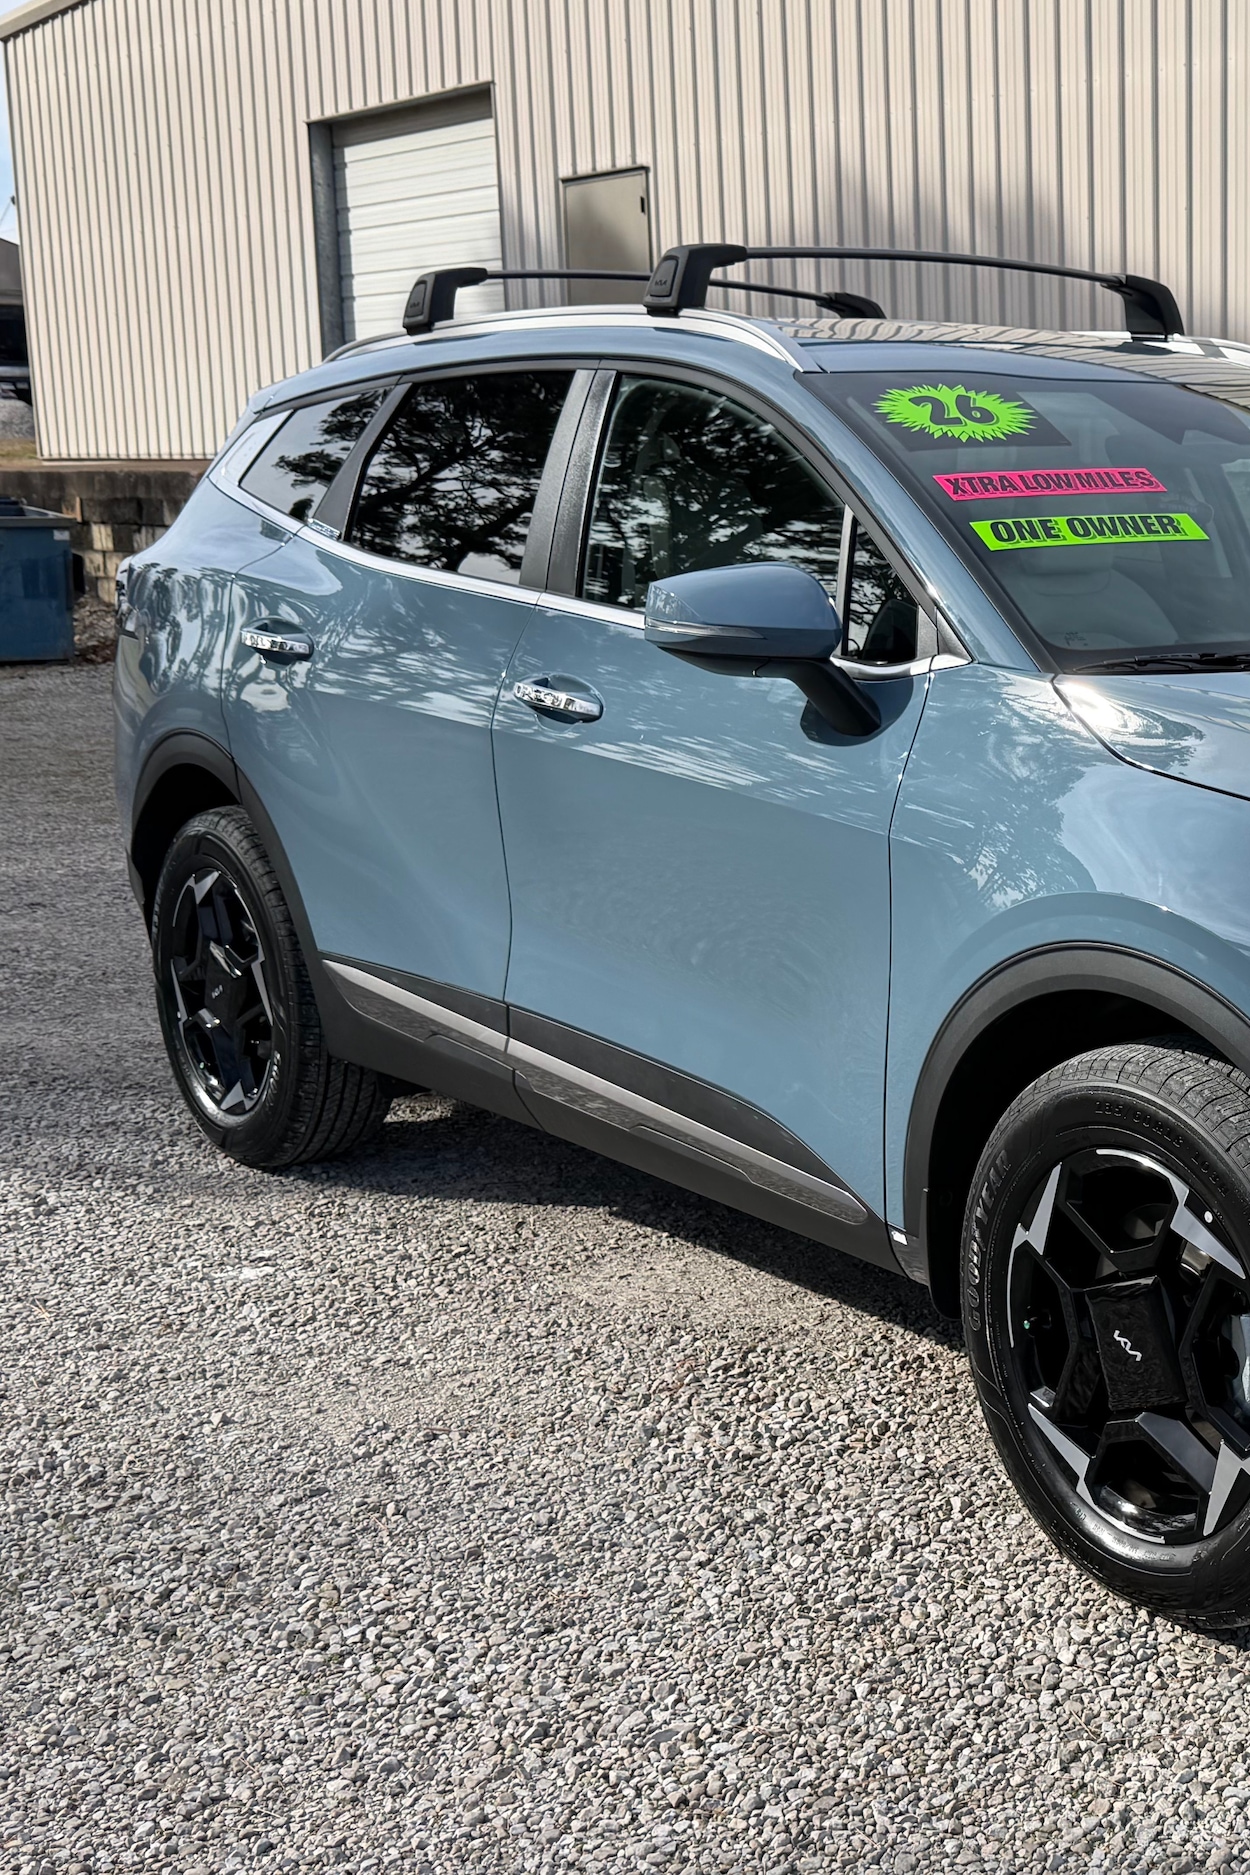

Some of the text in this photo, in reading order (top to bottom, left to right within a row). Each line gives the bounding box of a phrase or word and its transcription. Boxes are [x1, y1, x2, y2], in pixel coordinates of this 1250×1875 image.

[908, 394, 999, 426] 26
[944, 470, 1156, 497] XTRA LOW MILES
[989, 514, 1186, 544] ONE OWNER
[967, 1148, 1012, 1332] GOODYEAR
[1113, 1329, 1142, 1362] KIA
